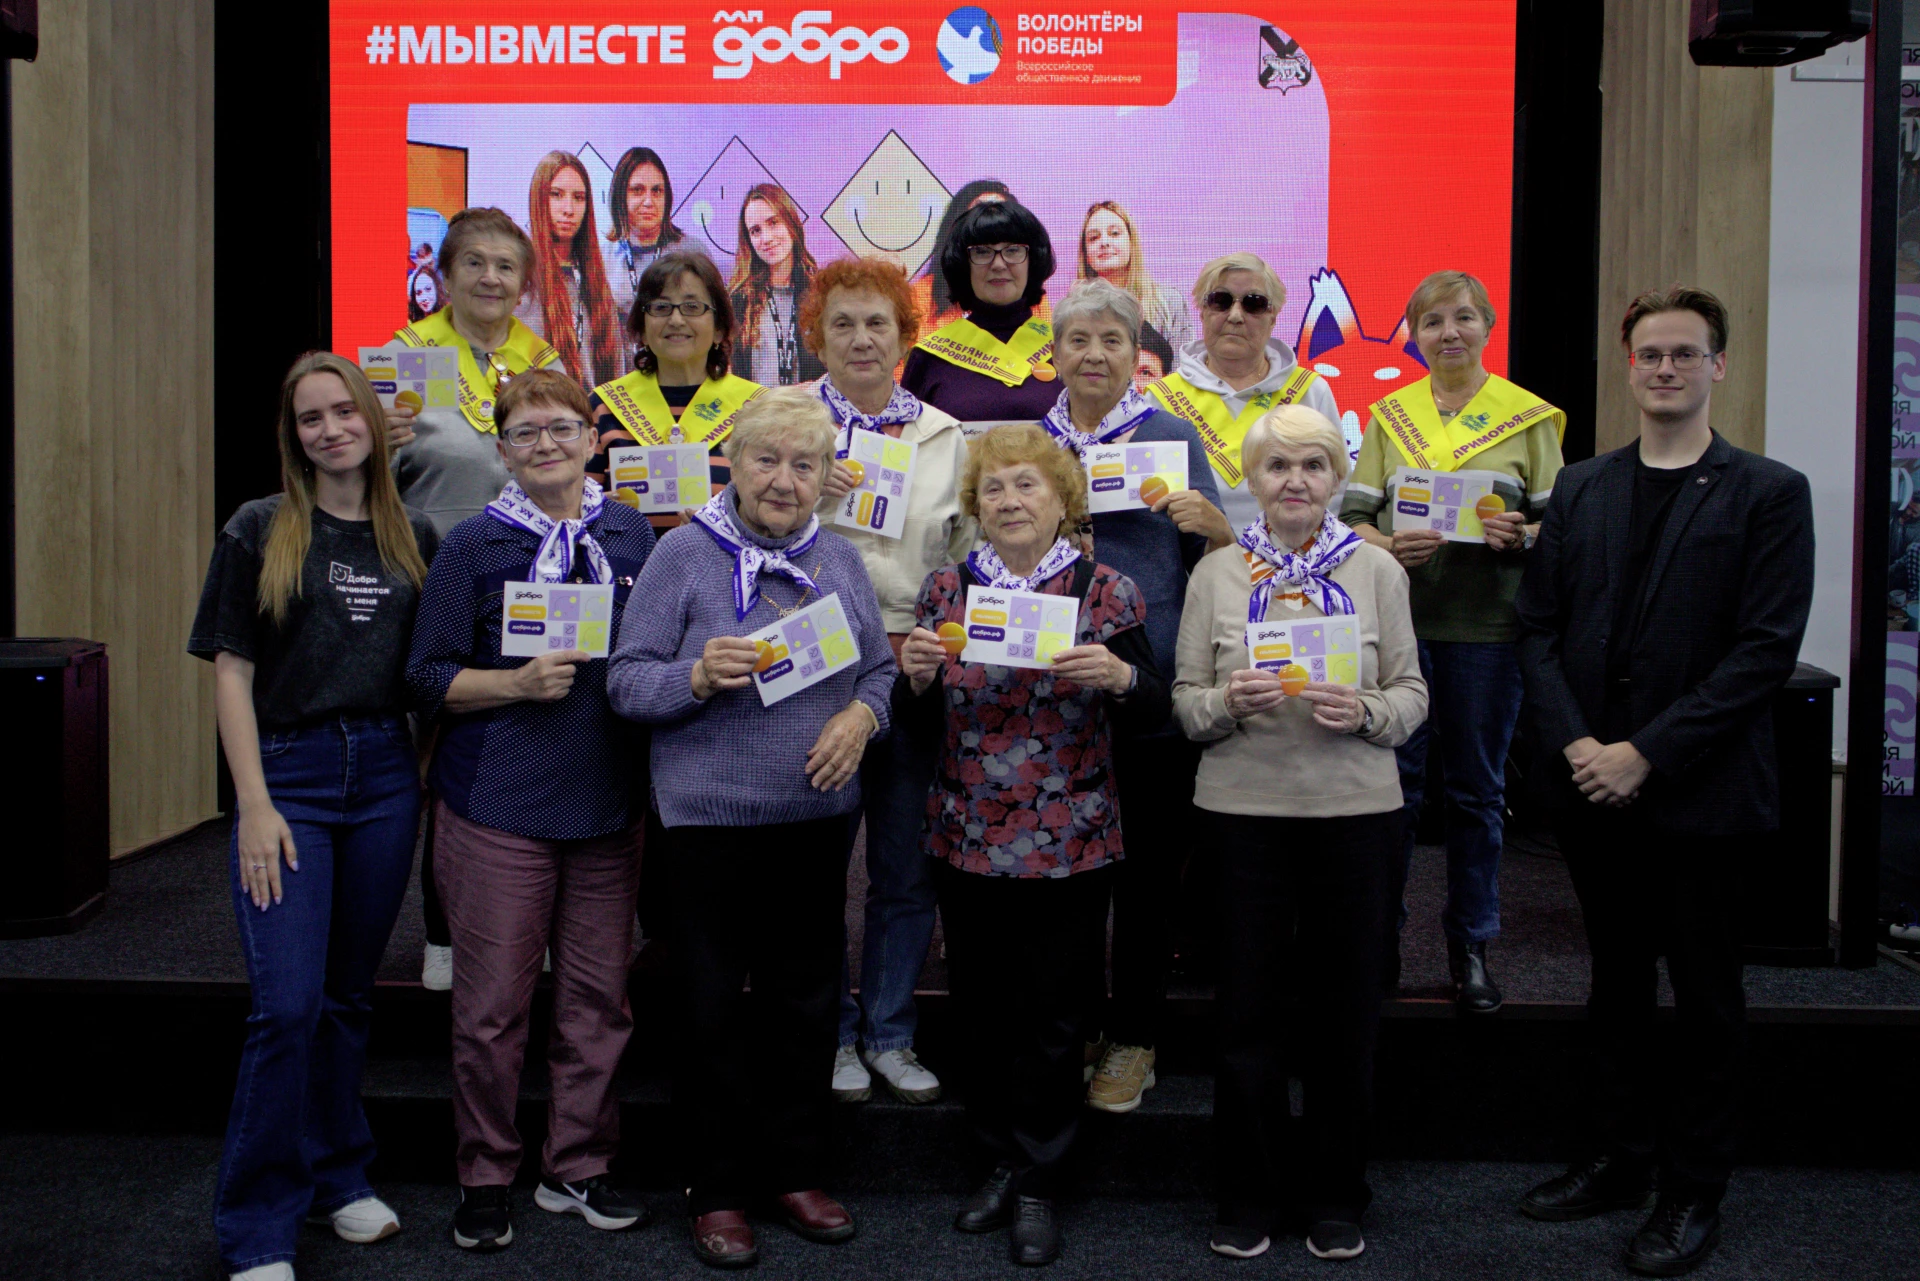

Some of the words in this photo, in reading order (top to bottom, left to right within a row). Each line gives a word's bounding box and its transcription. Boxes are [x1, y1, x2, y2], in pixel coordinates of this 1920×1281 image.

[1017, 14, 1143, 32] ВОЛОНТЁРЫ
[366, 25, 686, 65] #МЫВМЕСТЕ
[1017, 37, 1103, 56] ПОБЕДЫ
[1017, 60, 1094, 71] Всероссийское
[1016, 72, 1090, 83] общественное
[1091, 74, 1142, 84] движение
[924, 340, 994, 371] ДОБРОВОЛЬЦЫ
[931, 335, 1000, 364] СЕРЕБРЯНЫЕ
[1175, 391, 1228, 450] СЕРЕБРЯНЫЕ
[1378, 405, 1420, 456] ДОБРОВОЛЬЦЫ
[1389, 399, 1430, 450] СЕРЕБРЯНЫЕ
[1453, 414, 1525, 459] ПРИМОРЬЯ
[336, 585, 390, 595] начинается
[347, 575, 378, 584] Добро
[354, 598, 378, 606] меня
